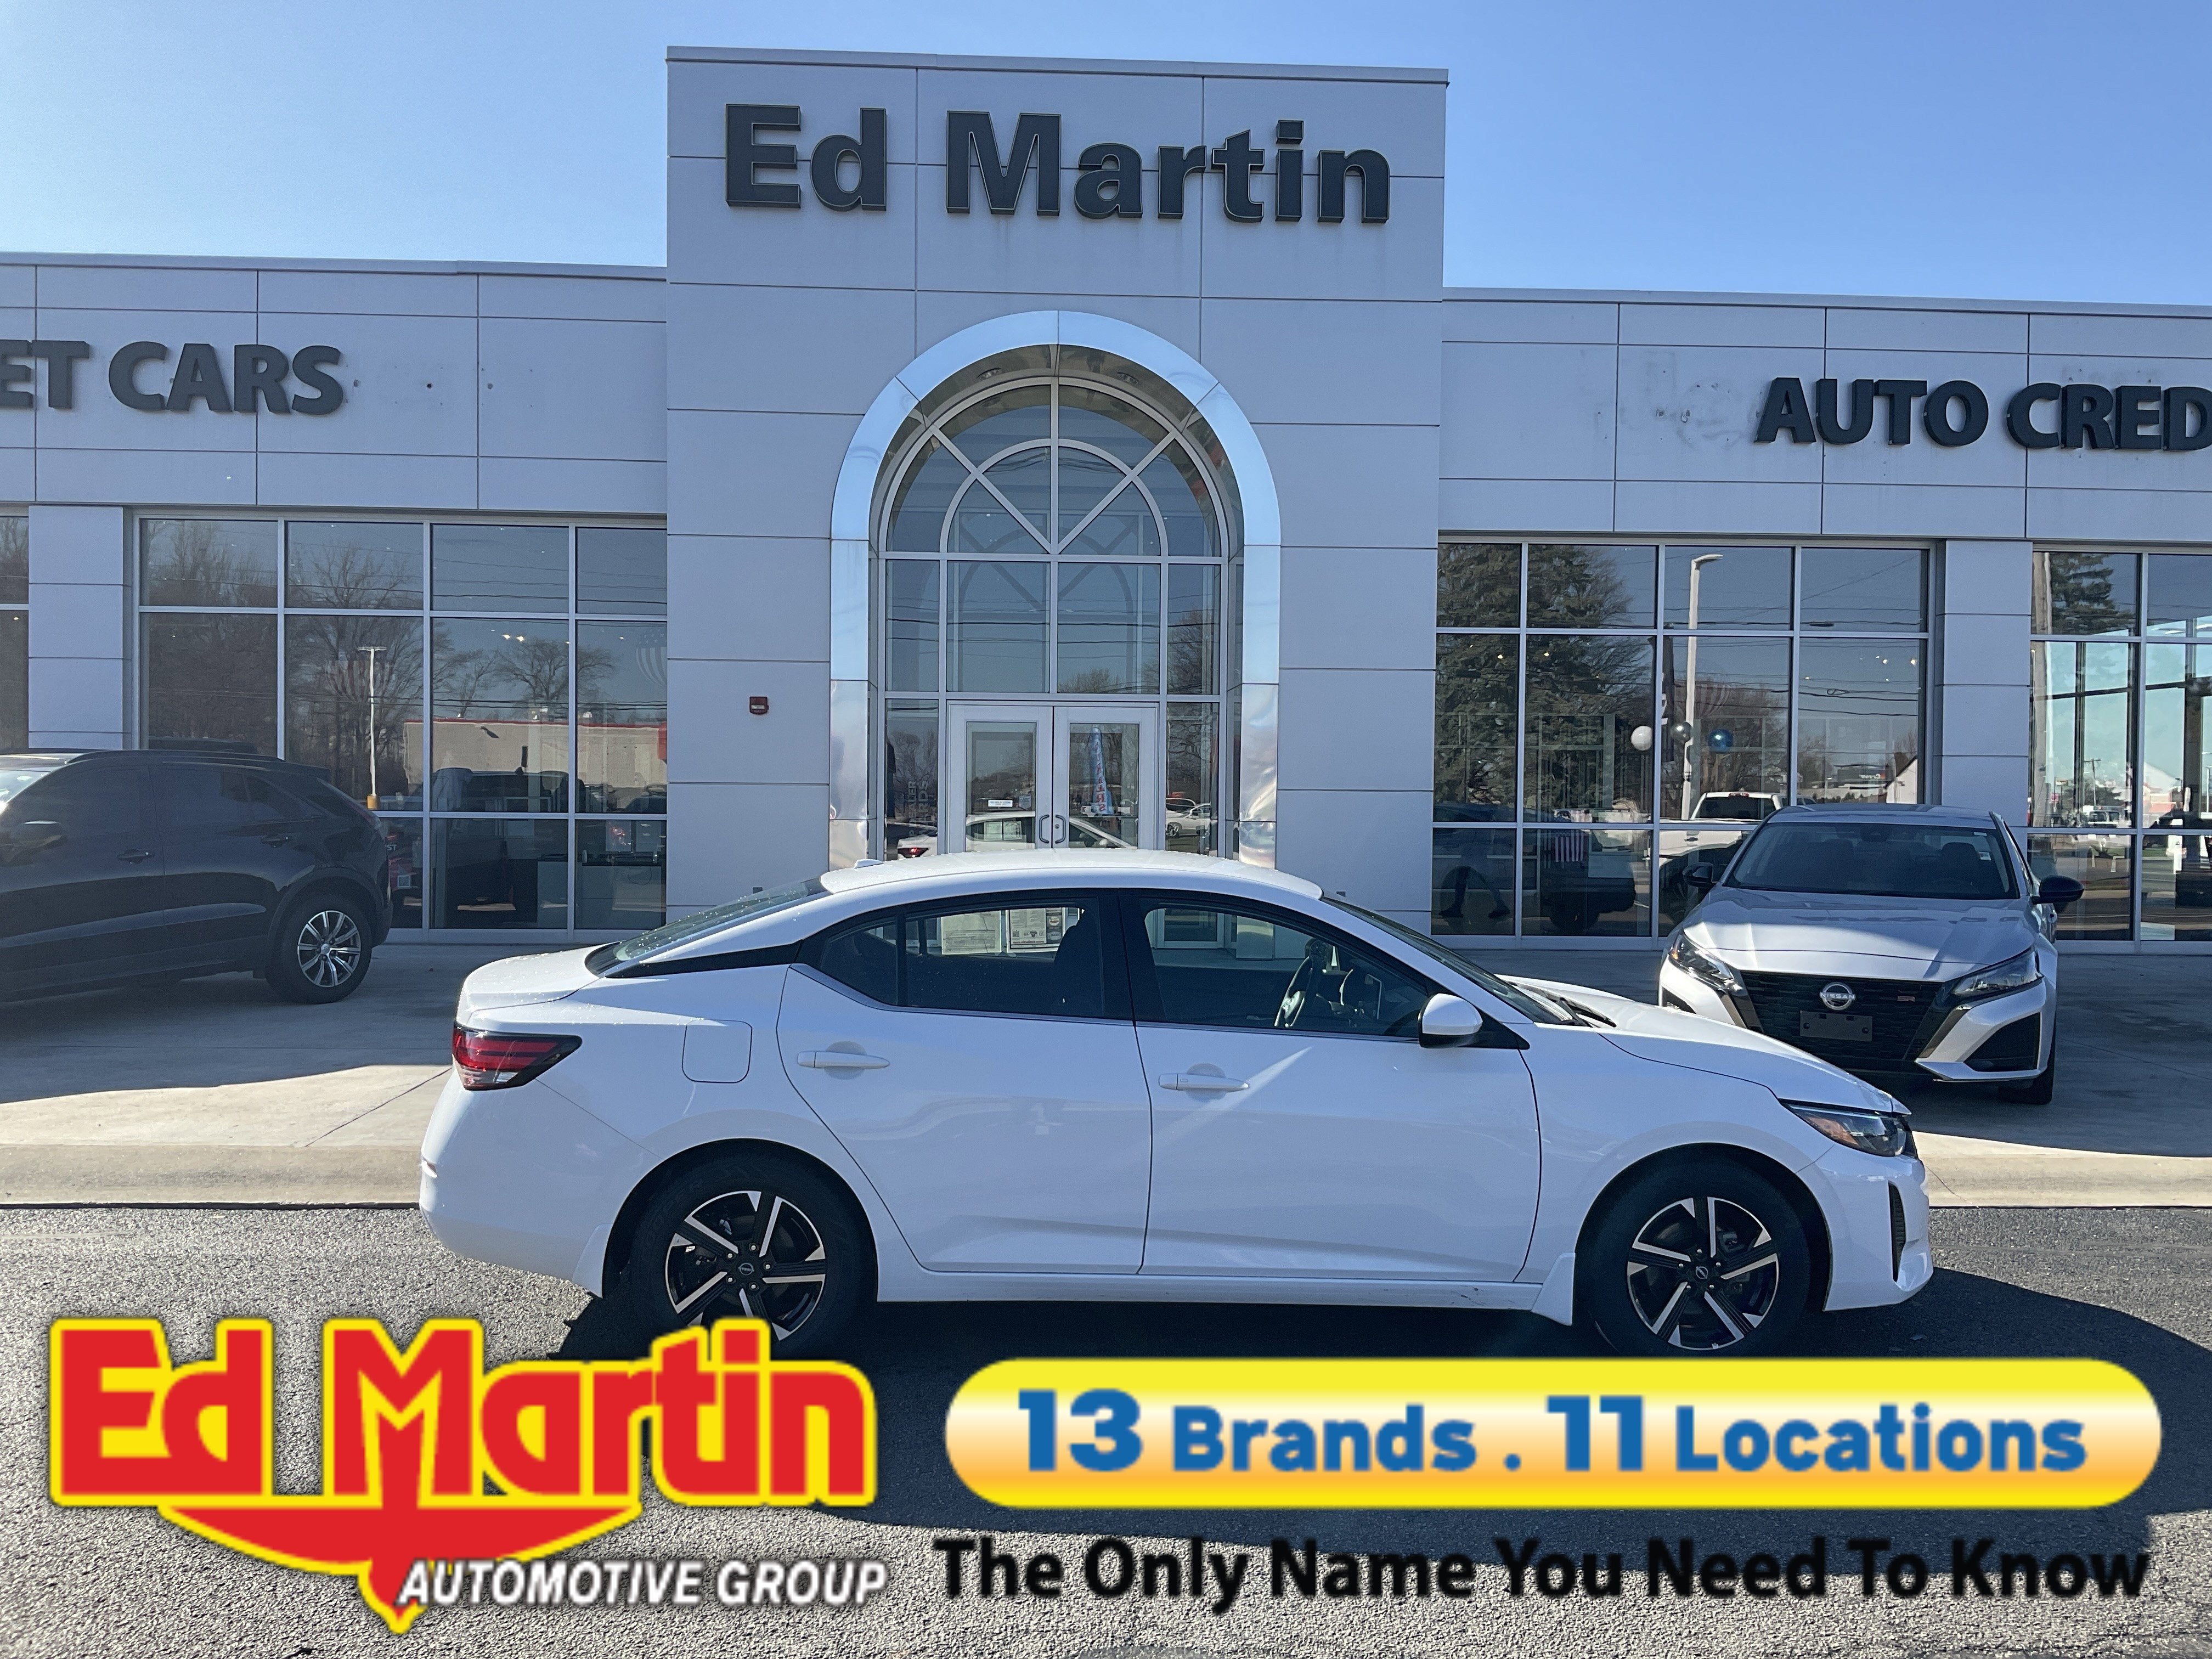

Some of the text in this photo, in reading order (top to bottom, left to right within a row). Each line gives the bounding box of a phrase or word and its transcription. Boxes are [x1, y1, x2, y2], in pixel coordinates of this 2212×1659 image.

[725, 103, 1391, 224] Ed Martin
[109, 340, 344, 415] CARS
[1755, 377, 1989, 447] AUTO
